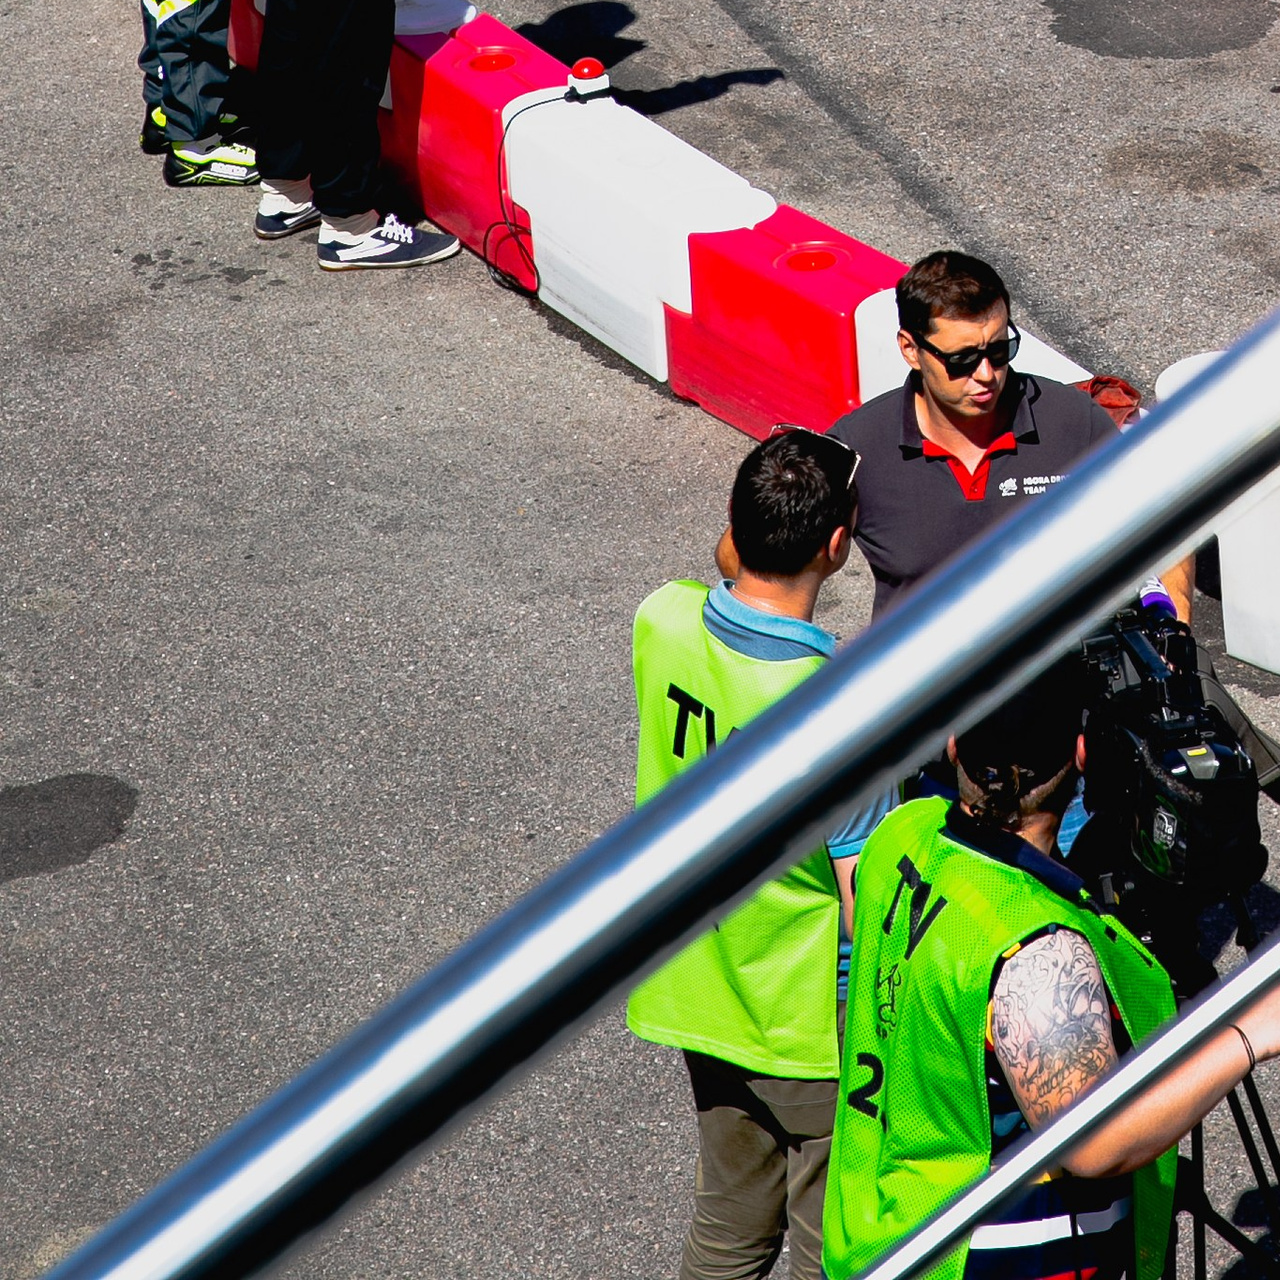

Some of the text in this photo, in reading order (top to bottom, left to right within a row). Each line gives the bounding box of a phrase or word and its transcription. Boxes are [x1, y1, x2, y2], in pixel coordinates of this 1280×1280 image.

[1023, 476, 1050, 486] IGORA
[1023, 486, 1046, 495] TEAM
[883, 854, 948, 961] TV
